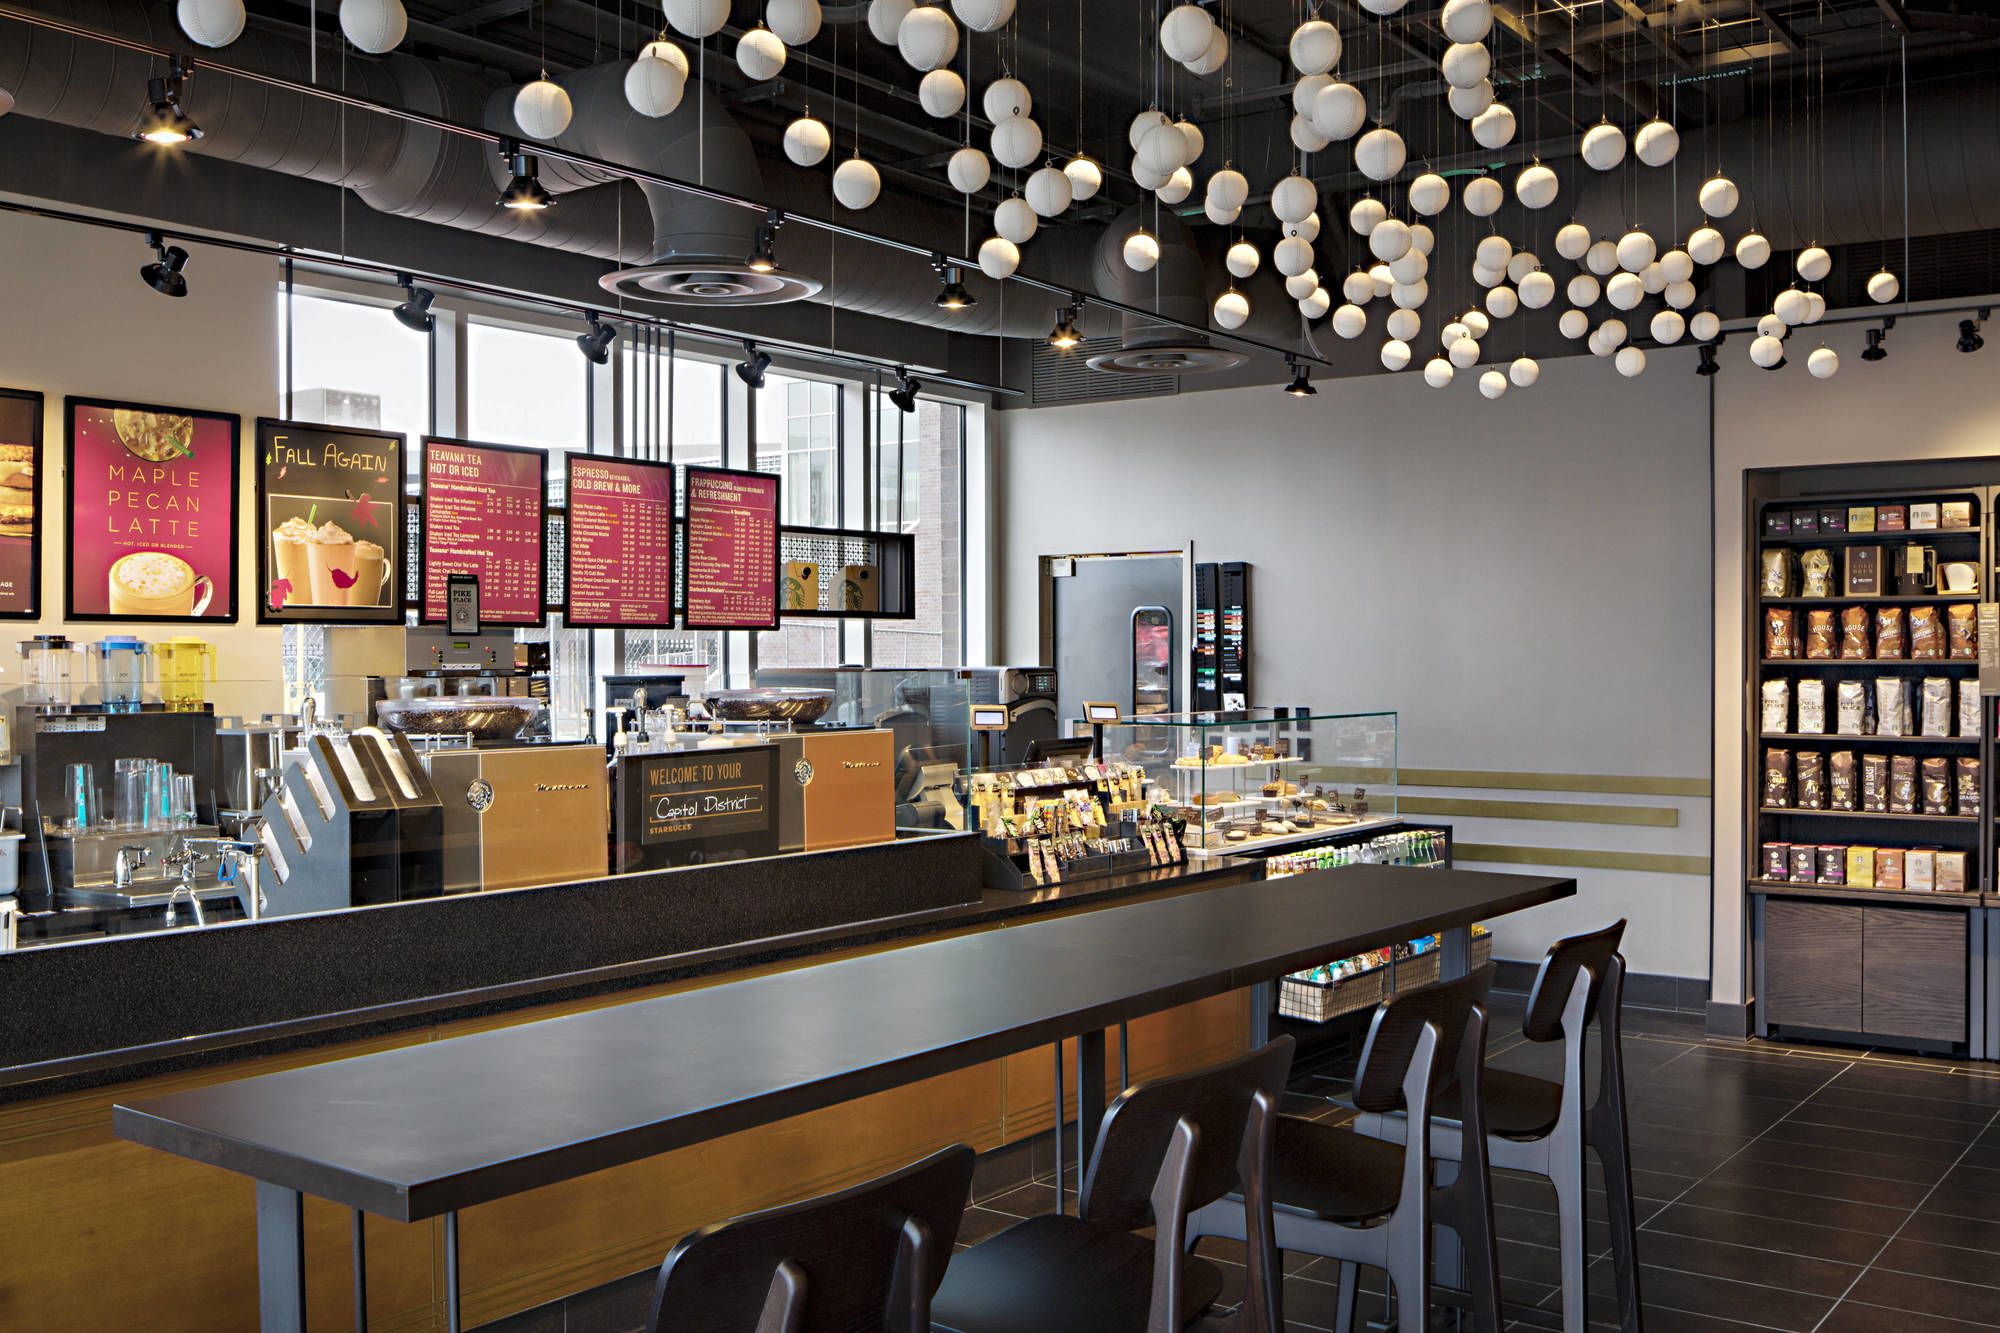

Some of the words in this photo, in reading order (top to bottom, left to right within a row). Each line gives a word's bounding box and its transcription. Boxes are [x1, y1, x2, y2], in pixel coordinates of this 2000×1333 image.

[274, 436, 316, 466] FALL
[323, 443, 387, 472] AGAIN
[430, 449, 465, 463] TEAVANA
[467, 453, 482, 465] TEA
[109, 464, 200, 488] MAPLE
[430, 463, 447, 474] HOT
[449, 465, 459, 475] OR
[461, 466, 480, 477] ICED
[573, 466, 609, 480] ESPRESSO
[573, 478, 591, 490] COLD
[593, 480, 613, 492] BREW
[615, 482, 621, 492] &
[622, 483, 640, 494] MORE
[691, 477, 732, 490] FRAPPUCCINO
[108, 490, 199, 513] PECAN
[698, 489, 741, 502] REFRESHMENT
[108, 516, 199, 537] LATTE
[1812, 625, 1834, 633] HOUSE
[1844, 624, 1865, 633] HOUSE
[650, 766, 699, 786] WELCOME
[702, 764, 714, 781] TO
[717, 762, 742, 780] YOUR
[656, 797, 698, 819] Capitol
[704, 794, 758, 812] District
[650, 824, 693, 834] STARBUCKS
